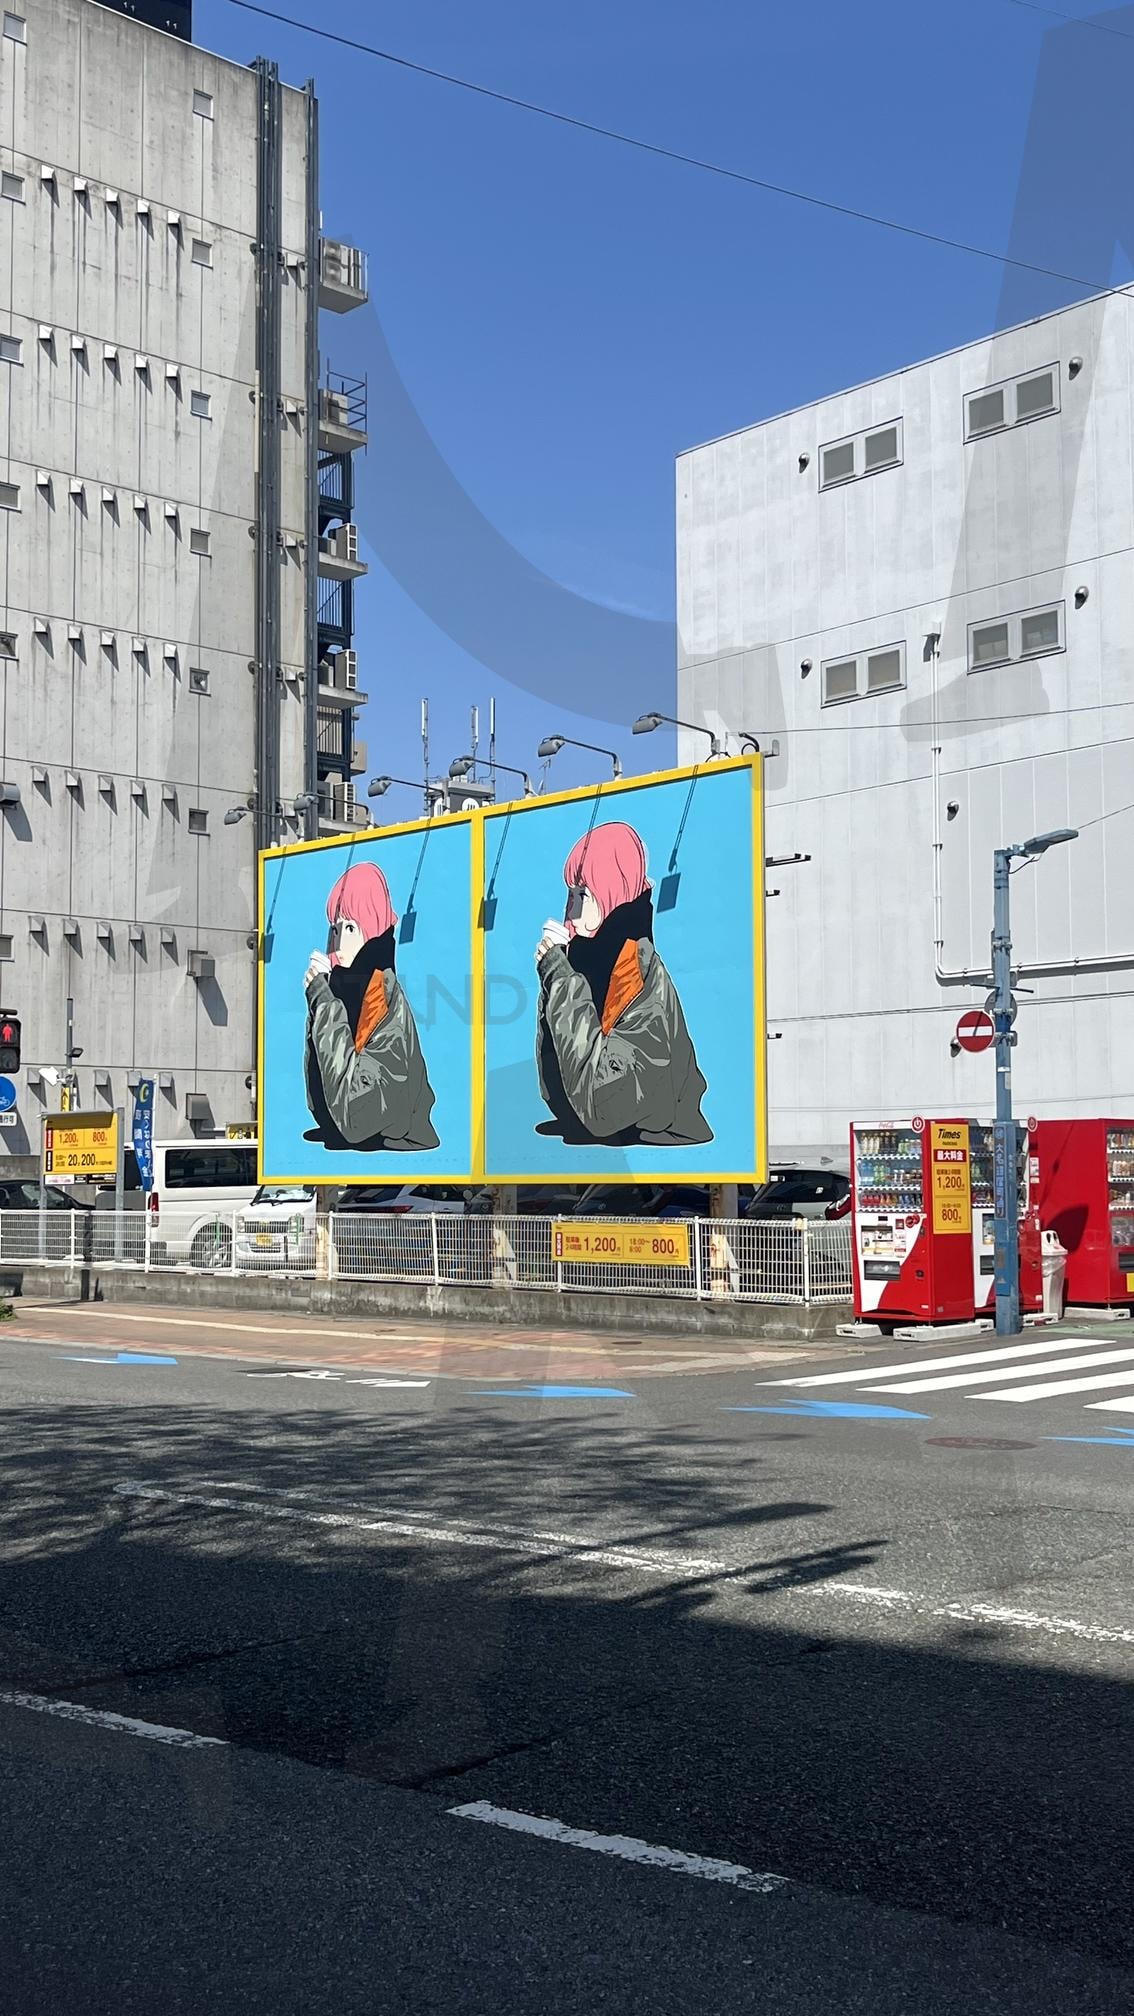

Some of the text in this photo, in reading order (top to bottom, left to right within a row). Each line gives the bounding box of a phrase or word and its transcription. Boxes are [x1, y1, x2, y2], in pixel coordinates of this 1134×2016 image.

[938, 1129, 961, 1139] Times
[937, 1150, 964, 1160] 最大料金
